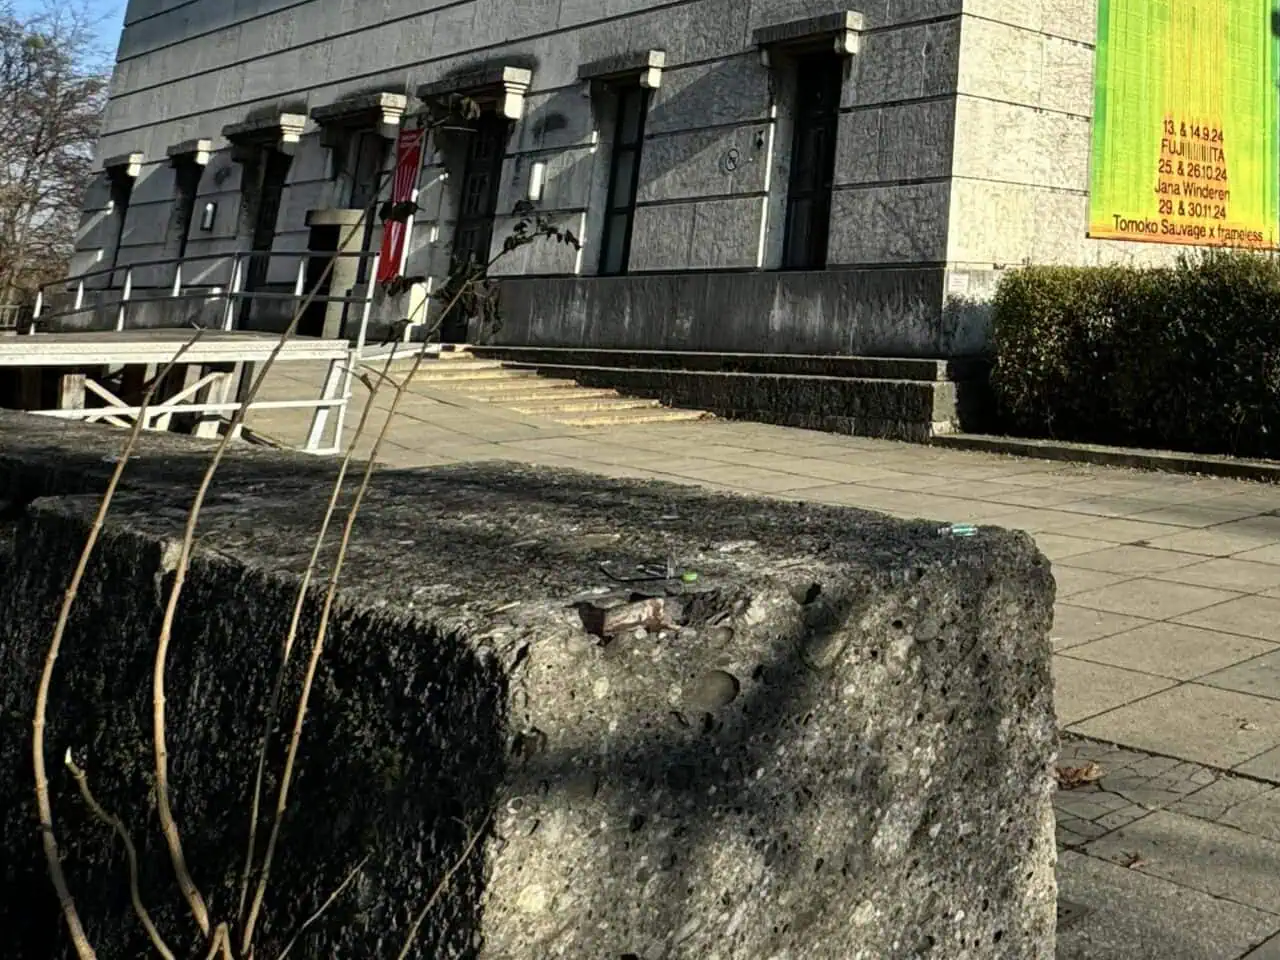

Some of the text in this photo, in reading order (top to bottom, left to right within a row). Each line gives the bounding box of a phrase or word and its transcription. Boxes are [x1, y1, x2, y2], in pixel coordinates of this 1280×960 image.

[1163, 119, 1176, 137] 13.
[1180, 121, 1187, 137] &
[1158, 158, 1173, 175] 25.
[1177, 160, 1185, 177] &
[1154, 177, 1231, 202] Jana Winderen
[1158, 199, 1174, 216] 29.
[1178, 200, 1185, 217] &
[1112, 213, 1264, 242] Tomoko Sauvage x frameless
